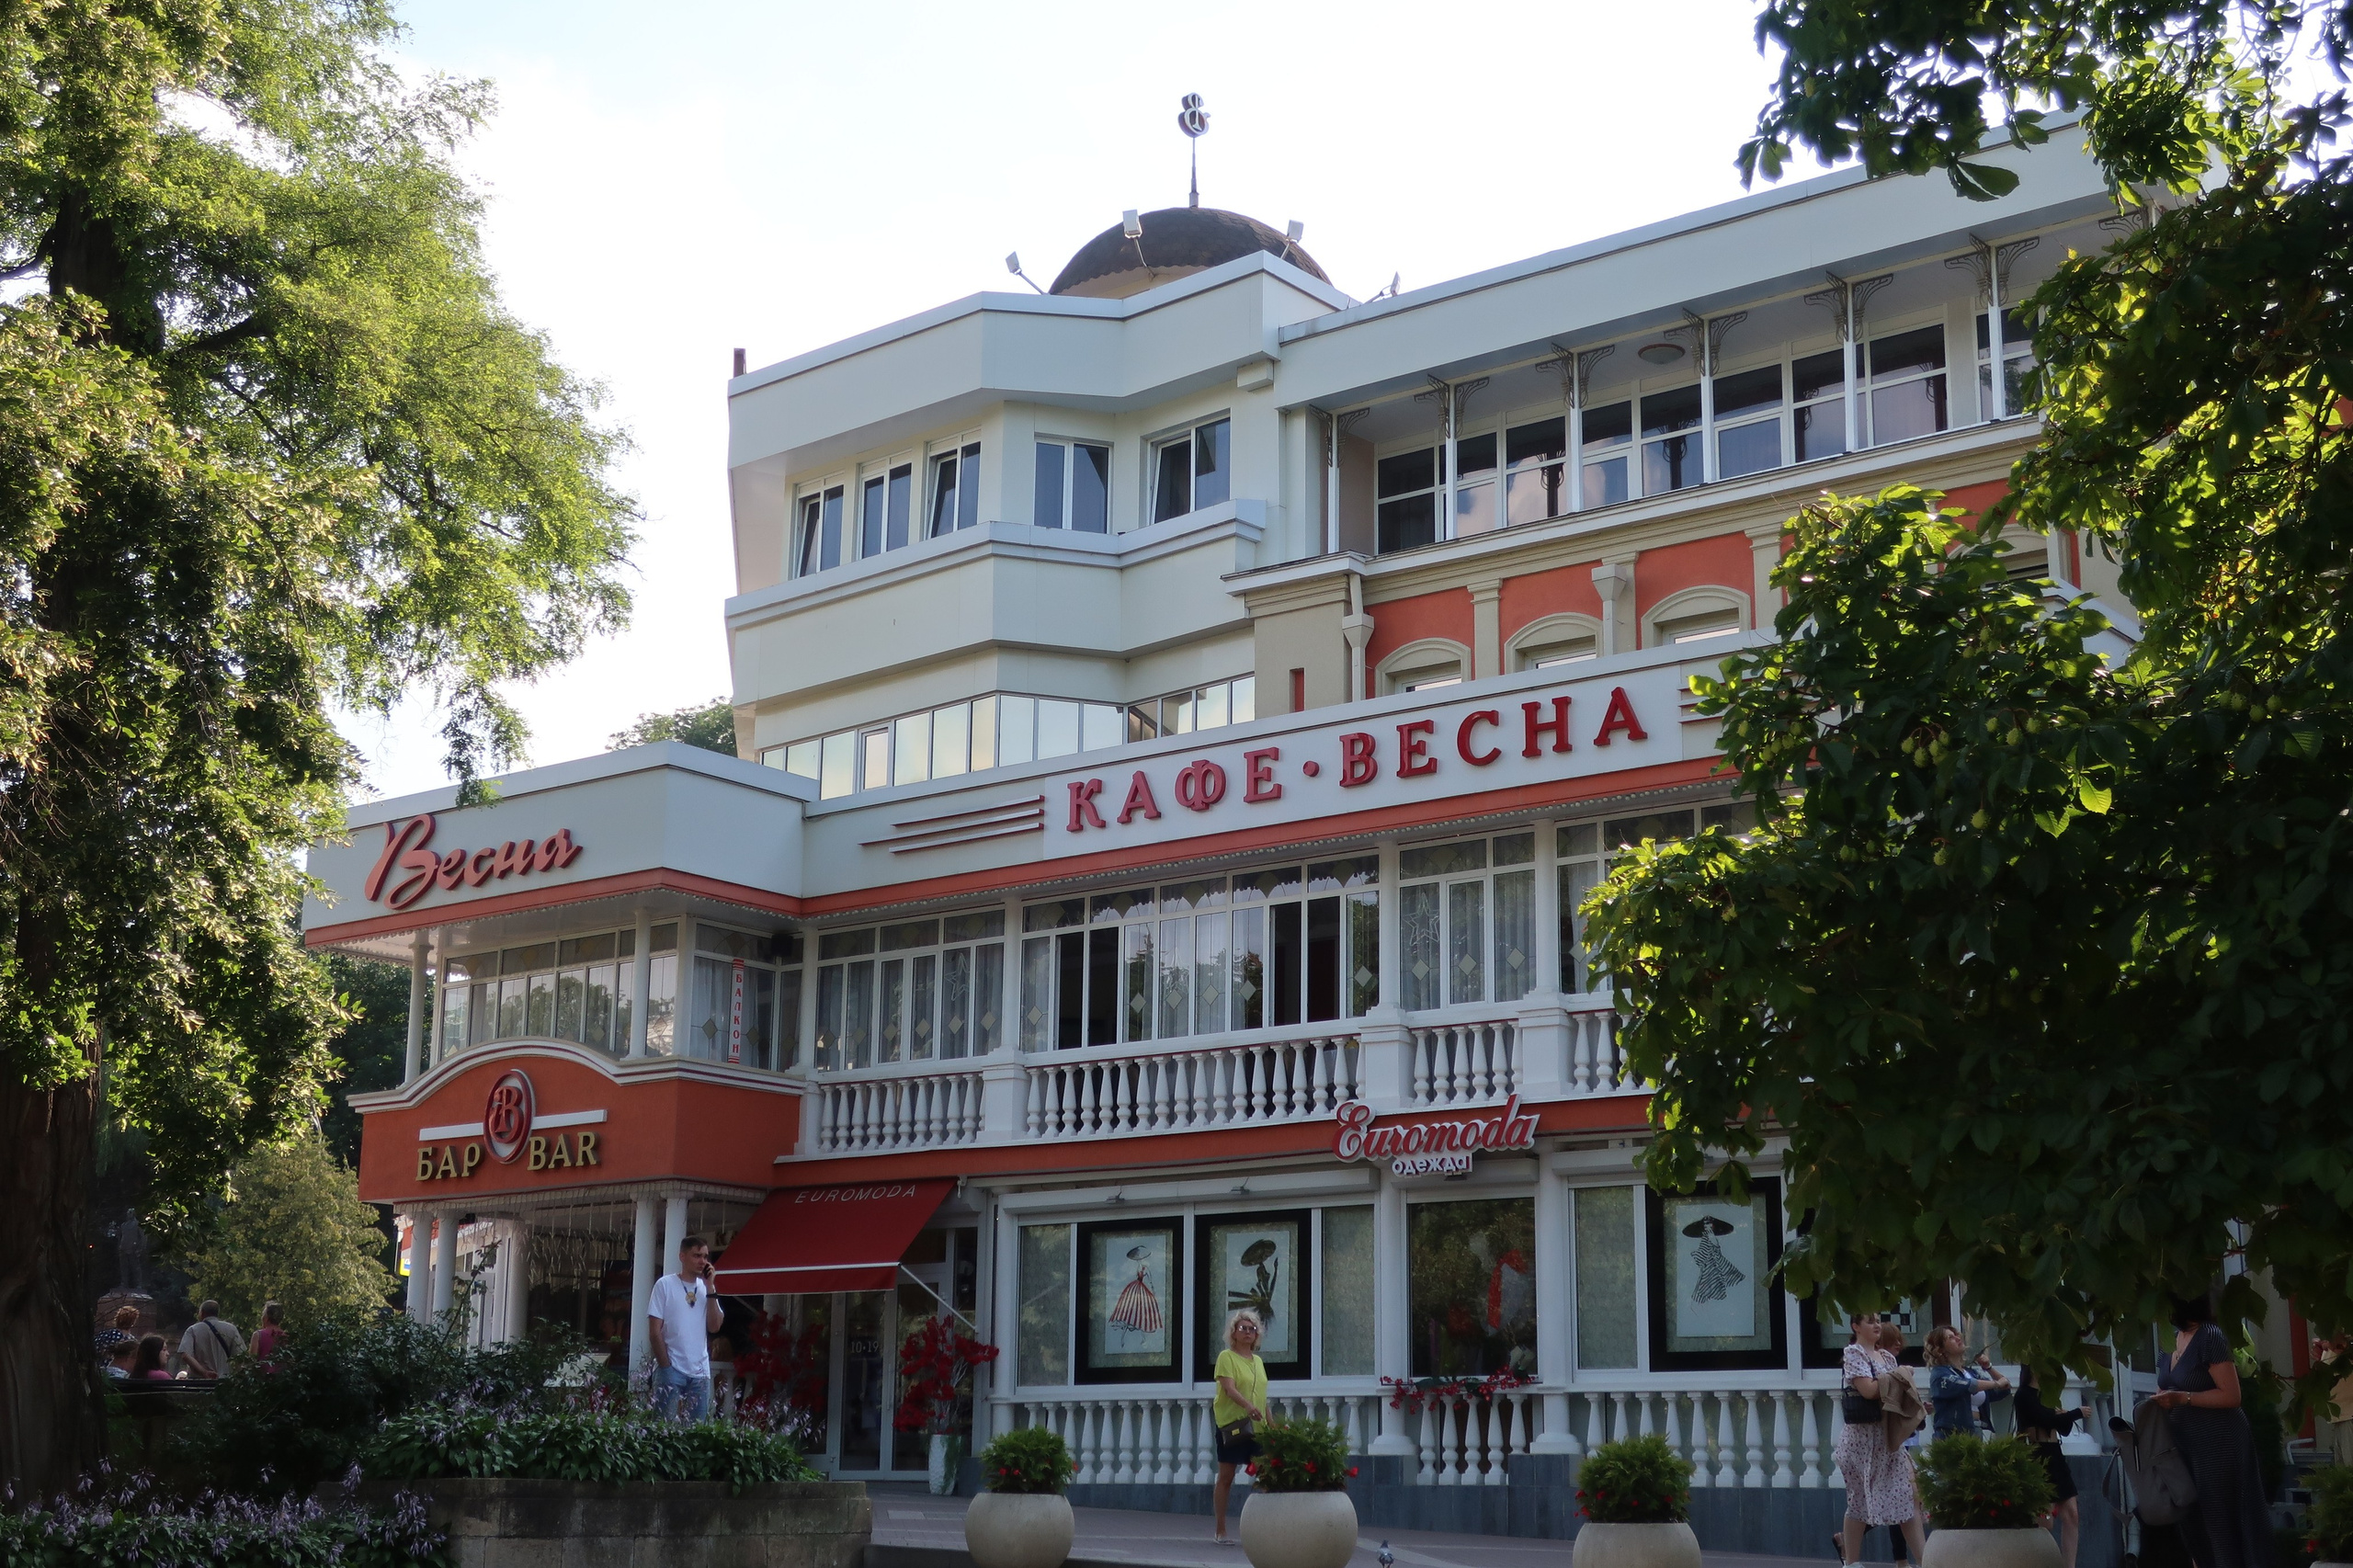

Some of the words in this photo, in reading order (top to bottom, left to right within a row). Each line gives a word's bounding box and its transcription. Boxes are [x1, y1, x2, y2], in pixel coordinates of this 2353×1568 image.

[1066, 746, 1282, 832] КАФЕ
[1338, 687, 1649, 789] ВЕСНА
[365, 813, 584, 910] Весна
[732, 973, 744, 1054] БАЛКОН
[527, 1131, 600, 1172] BAR
[1333, 1093, 1539, 1162] Euromoda
[415, 1142, 485, 1182] БАР
[1392, 1153, 1471, 1176] одежда
[794, 1184, 917, 1205] EUROMODA
